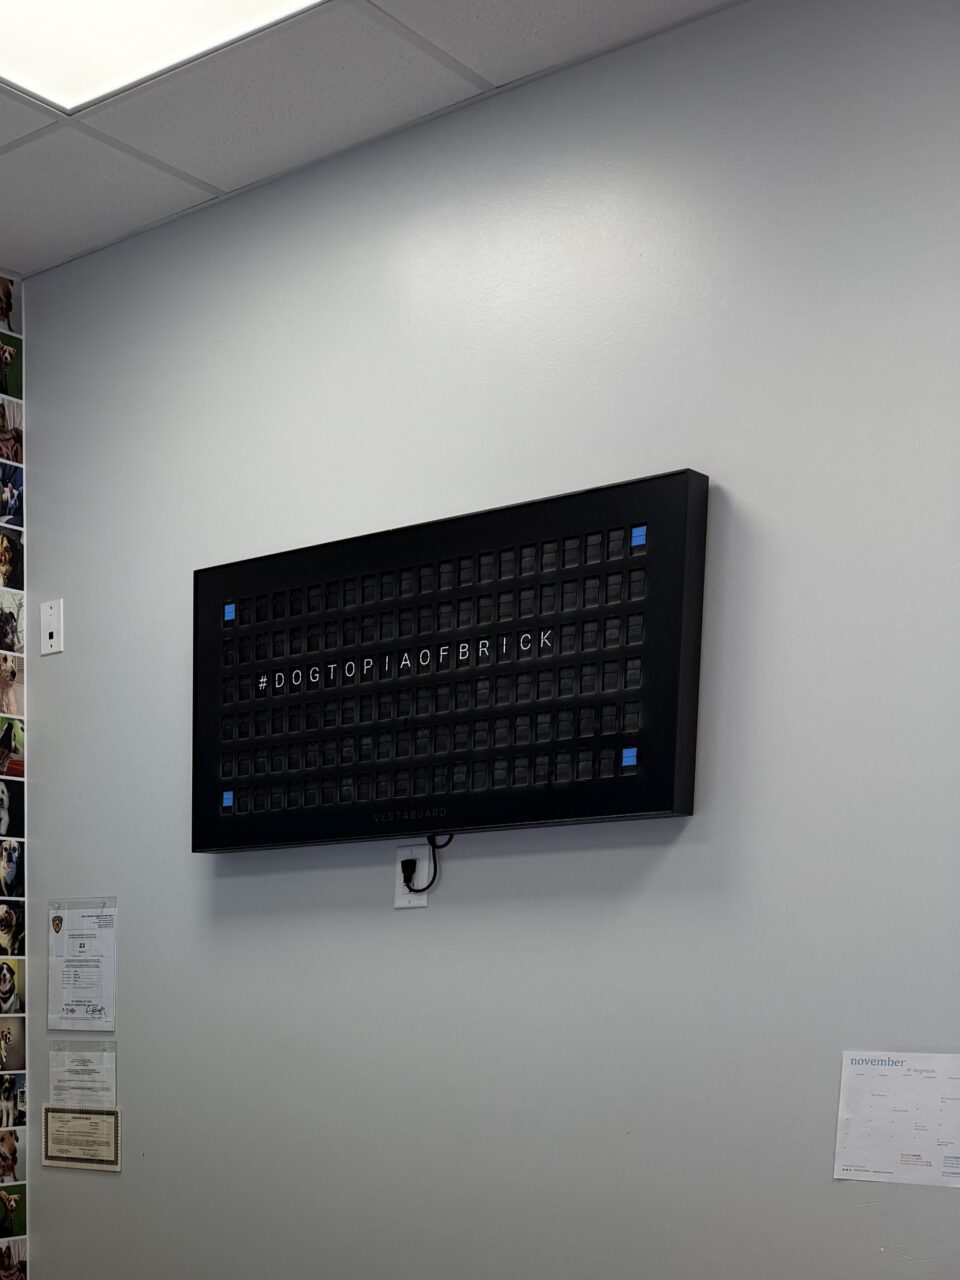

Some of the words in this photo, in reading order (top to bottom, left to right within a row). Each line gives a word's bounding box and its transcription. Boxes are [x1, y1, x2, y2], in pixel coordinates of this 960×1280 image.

[258, 630, 552, 690] #DOGTOPIAOFBRICK
[373, 807, 447, 823] VESTABOARD
[850, 1057, 906, 1067] november
